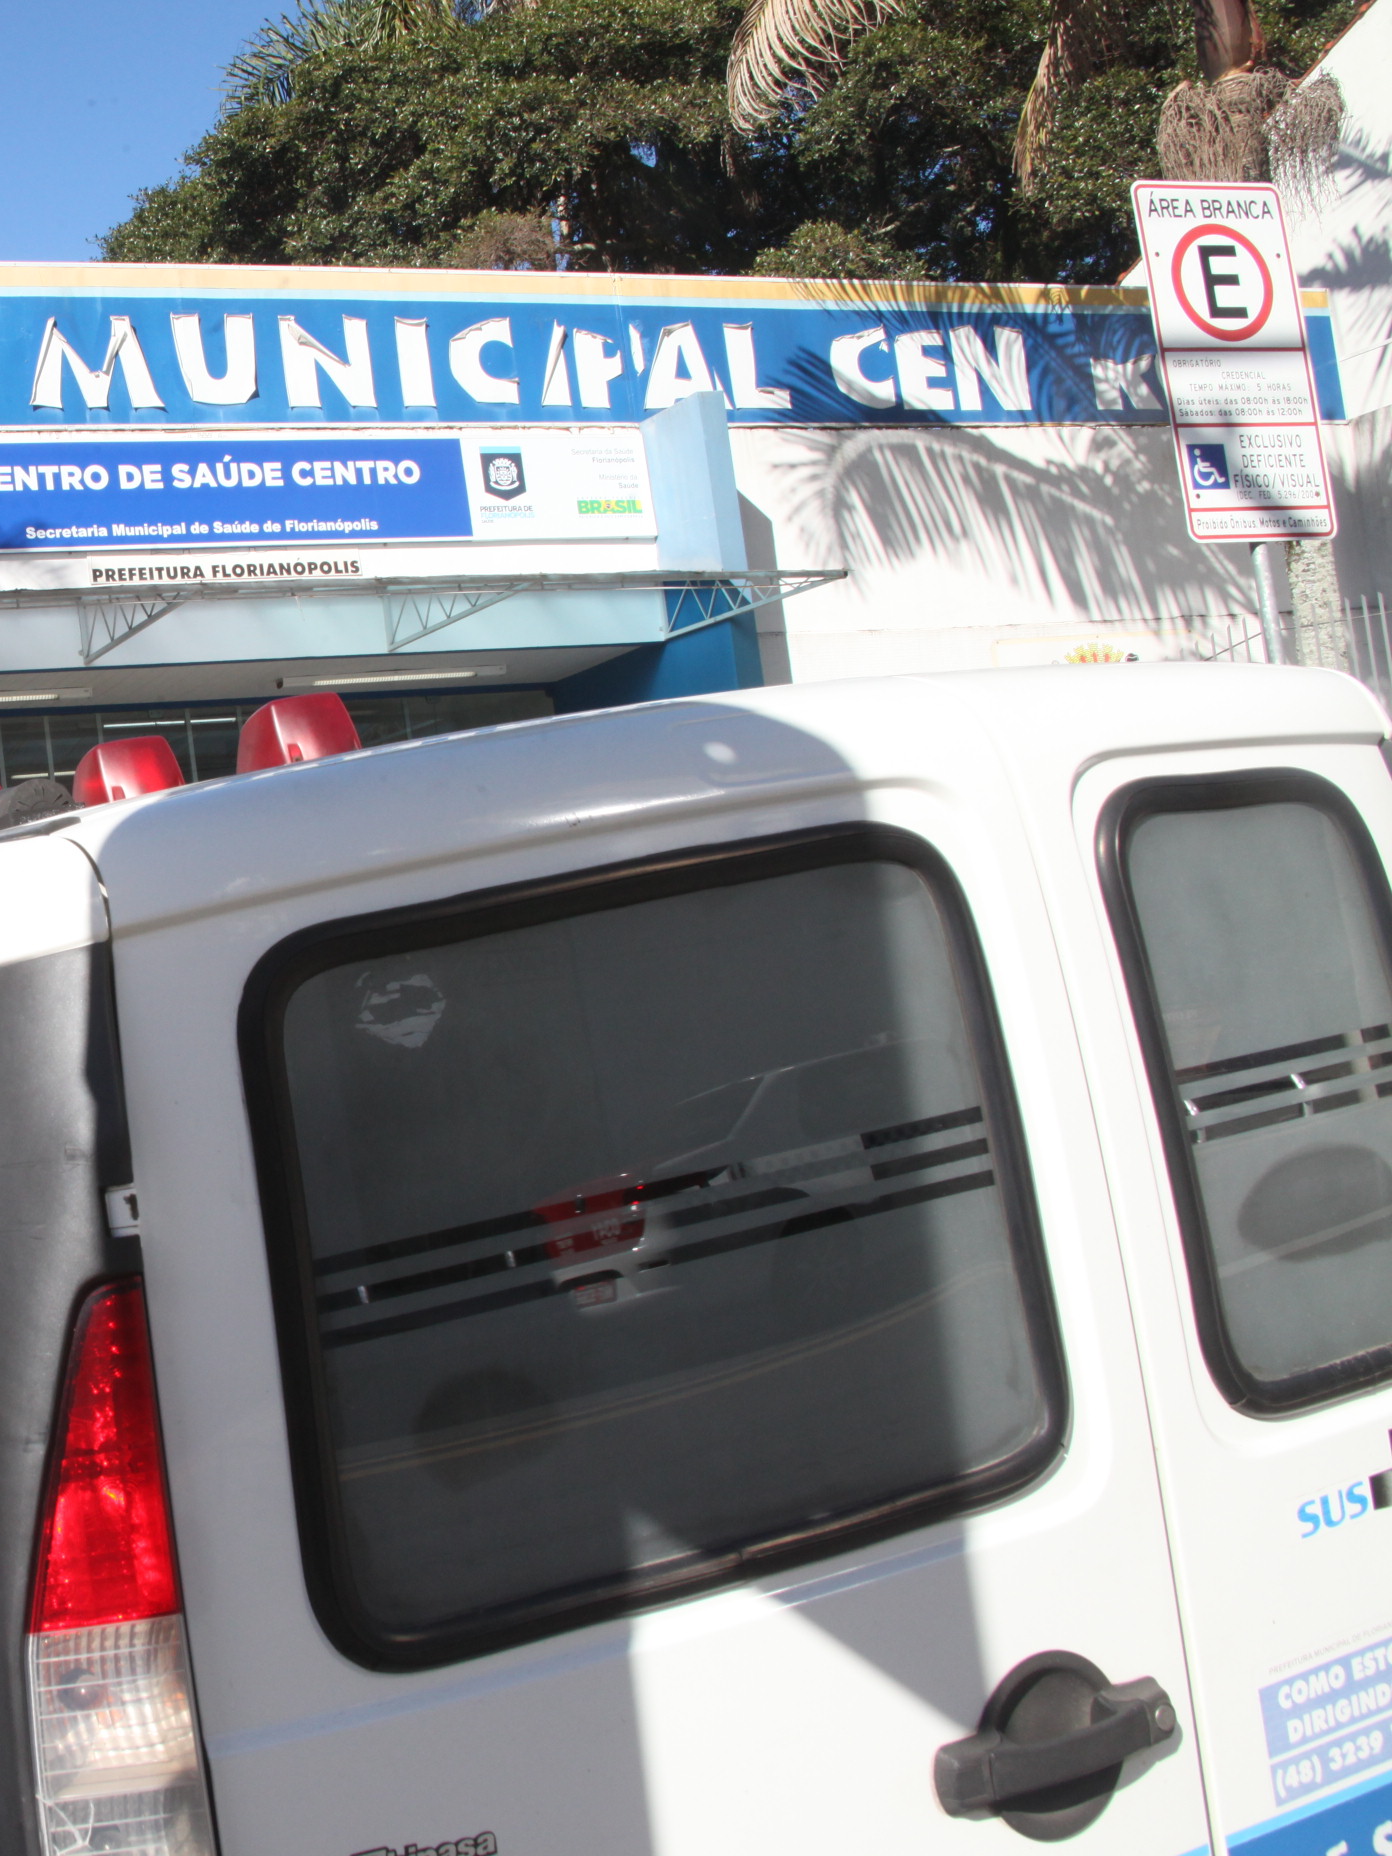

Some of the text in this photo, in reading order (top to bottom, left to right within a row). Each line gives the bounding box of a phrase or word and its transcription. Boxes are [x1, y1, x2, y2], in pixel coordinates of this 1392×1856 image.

[1148, 191, 1274, 220] ÁREA BRANCA
[1197, 245, 1249, 319] E
[29, 312, 791, 412] MUNICIPAL
[1172, 358, 1222, 368] OBRIGATÓRIO
[1221, 371, 1266, 380] CREDENCIAL
[1189, 383, 1213, 391] TEMPO
[1257, 383, 1262, 391] 5
[1267, 383, 1292, 391] HORAS
[1176, 397, 1195, 406] Dias
[1224, 397, 1238, 405] das
[1241, 397, 1269, 405] 08:00h
[1179, 408, 1216, 417] Sábados:
[1218, 408, 1233, 417] das
[1235, 408, 1263, 416] 08:00h
[1277, 407, 1303, 416] 12:00h
[1239, 434, 1302, 449] EXCLUSIVO
[1241, 453, 1306, 469] DEFICIENTE
[120, 463, 165, 491] DE
[172, 454, 283, 492] SAÚDE
[291, 459, 422, 488] CENTRO
[1233, 469, 1321, 489] FÍSICO/VISUAL
[480, 505, 522, 513] PREFEITURA
[577, 499, 643, 515] BRASIL
[25, 517, 379, 539] Secretaria Municipal de Saúde de Florianópolis
[1196, 518, 1229, 530] Proibido
[1259, 517, 1281, 528] Motos
[1282, 519, 1287, 527] e
[1288, 515, 1328, 528] Caminhões
[92, 557, 360, 583] PREFEITURA FLORIANÓPOLIS
[1296, 1480, 1369, 1540] SUS
[1277, 1664, 1346, 1711] COMO
[1286, 1681, 1392, 1744] DIRIGIND
[1275, 1729, 1384, 1799] (48) 3239
